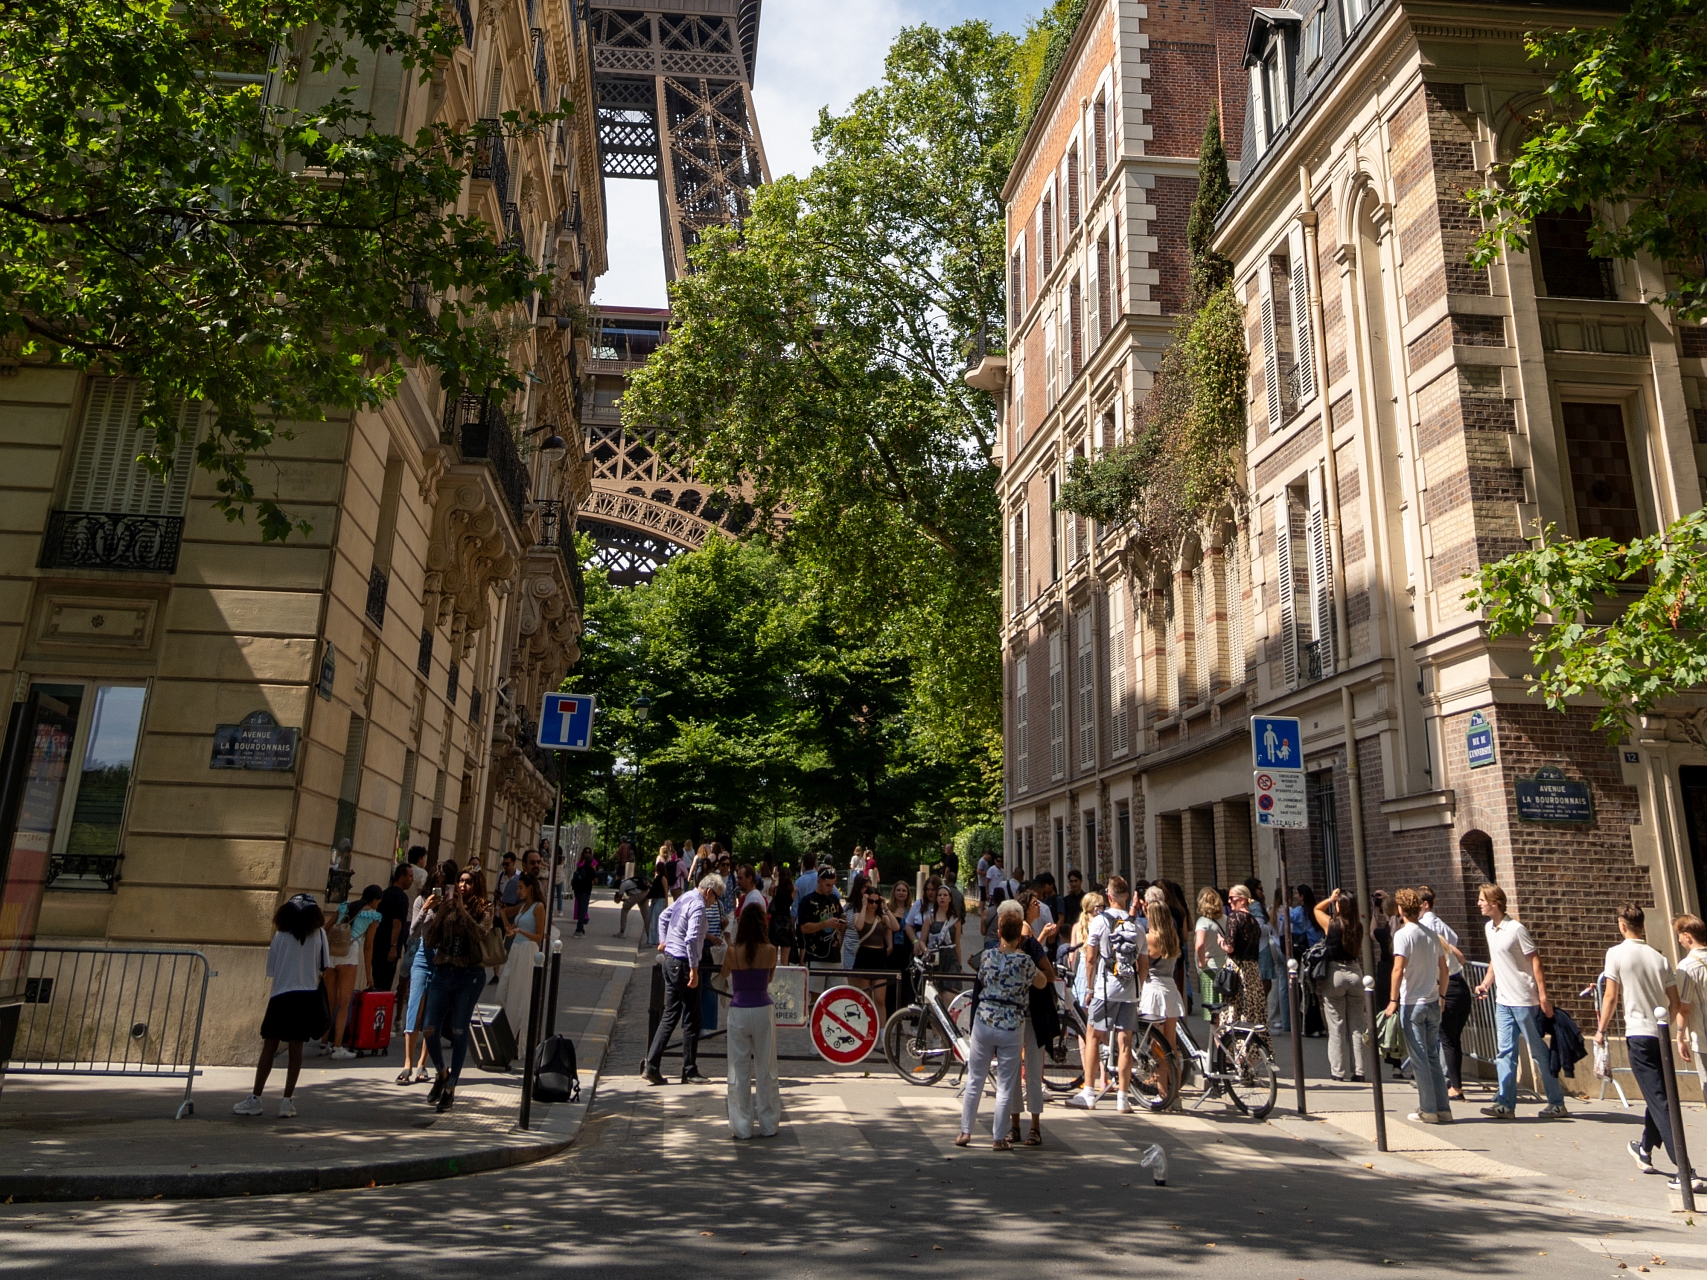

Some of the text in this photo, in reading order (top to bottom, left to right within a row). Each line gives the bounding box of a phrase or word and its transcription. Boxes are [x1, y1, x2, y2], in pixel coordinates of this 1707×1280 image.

[242, 731, 272, 739] AVENUE
[234, 742, 290, 752] BOURDONNAIS
[1626, 753, 1637, 762] 12
[1539, 785, 1566, 793] AVENUE
[1535, 796, 1586, 805] BOURDONNAIS
